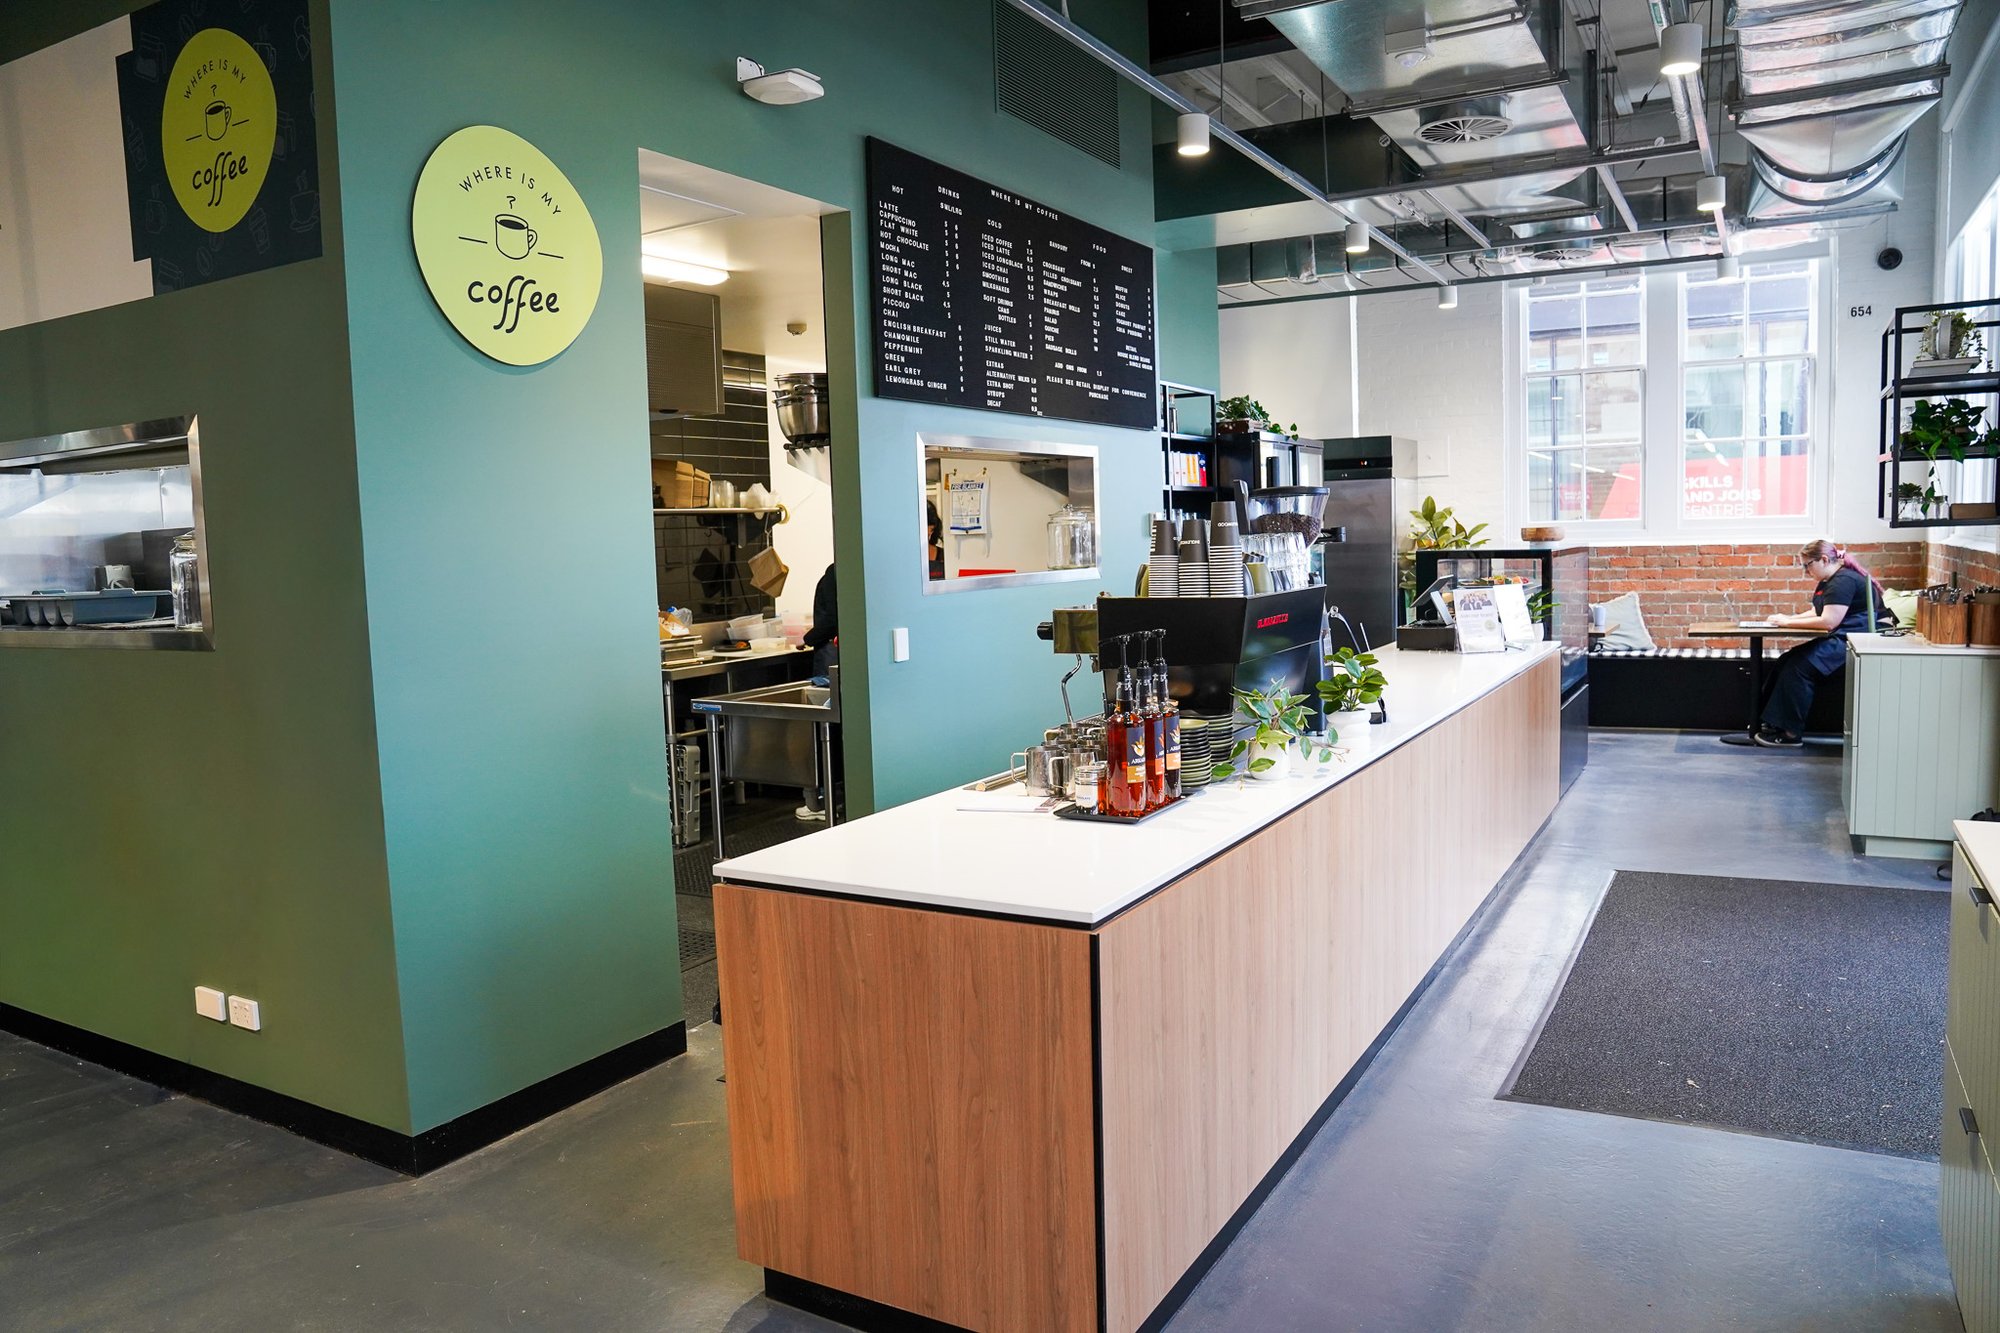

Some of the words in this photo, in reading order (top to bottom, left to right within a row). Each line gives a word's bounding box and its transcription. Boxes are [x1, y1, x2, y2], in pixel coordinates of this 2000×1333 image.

[184, 60, 214, 99] WHERE
[219, 59, 228, 70] IS
[232, 66, 246, 84] MY
[192, 151, 248, 207] coffee
[459, 166, 512, 192] WHERE
[521, 173, 535, 189] IS
[541, 192, 562, 215] MY
[892, 185, 903, 194] HOT
[938, 186, 959, 199] DRINKS
[879, 200, 898, 213] LATTE
[991, 189, 1010, 202] WHERE
[1036, 207, 1058, 220] COFFEE
[879, 210, 916, 227] CAPPUCCINO
[987, 219, 1002, 229] COLD
[880, 219, 895, 229] FLAT
[900, 225, 918, 237] WHITE
[880, 230, 891, 239] HOT
[896, 235, 928, 250] CHOCOLATE
[981, 233, 994, 242] ICED
[995, 238, 1012, 248] COFFEE
[880, 241, 900, 253] MOCHA
[981, 241, 994, 250] ICED
[996, 246, 1010, 256] LATTE
[1092, 243, 1106, 253] FOOD
[881, 252, 898, 263] LONG
[901, 258, 914, 268] MAC
[982, 251, 994, 260] ICED
[882, 264, 900, 274] SHORT
[904, 270, 917, 279] MAC
[982, 261, 995, 270] ICED
[996, 265, 1008, 274] CHAI
[982, 271, 1008, 283] SMOOTHIES
[1043, 270, 1057, 280] FILLED
[882, 275, 897, 285] LONG
[903, 280, 922, 291] BLACK
[982, 280, 1010, 293] MILKSHAKES
[882, 286, 901, 296] SHORT
[904, 291, 924, 302] BLACK
[983, 294, 995, 302] SOFT
[468, 275, 560, 334] coffee
[883, 297, 910, 309] PICCOLO
[883, 308, 898, 317] CHAI
[1850, 305, 1871, 317] 654
[998, 314, 1016, 323] BOTTLES
[883, 319, 911, 331] ENGLISH
[912, 325, 946, 338] BREAKFAST
[984, 324, 1001, 333] JUICES
[883, 330, 919, 343] CHAMOMILE
[984, 335, 997, 344] STILL
[1000, 338, 1015, 347] WATER
[884, 341, 922, 354] PEPPERMINT
[985, 345, 1012, 356] SPARKLING
[884, 353, 904, 362] GREEN
[885, 363, 901, 372] EARL
[904, 367, 920, 375] GREY
[986, 360, 1004, 369] EXTRAS
[885, 375, 924, 386] LEMONGRASS
[927, 381, 946, 390] GINGER
[986, 380, 1001, 388] EXTRA
[987, 390, 1005, 398] SYRUPS
